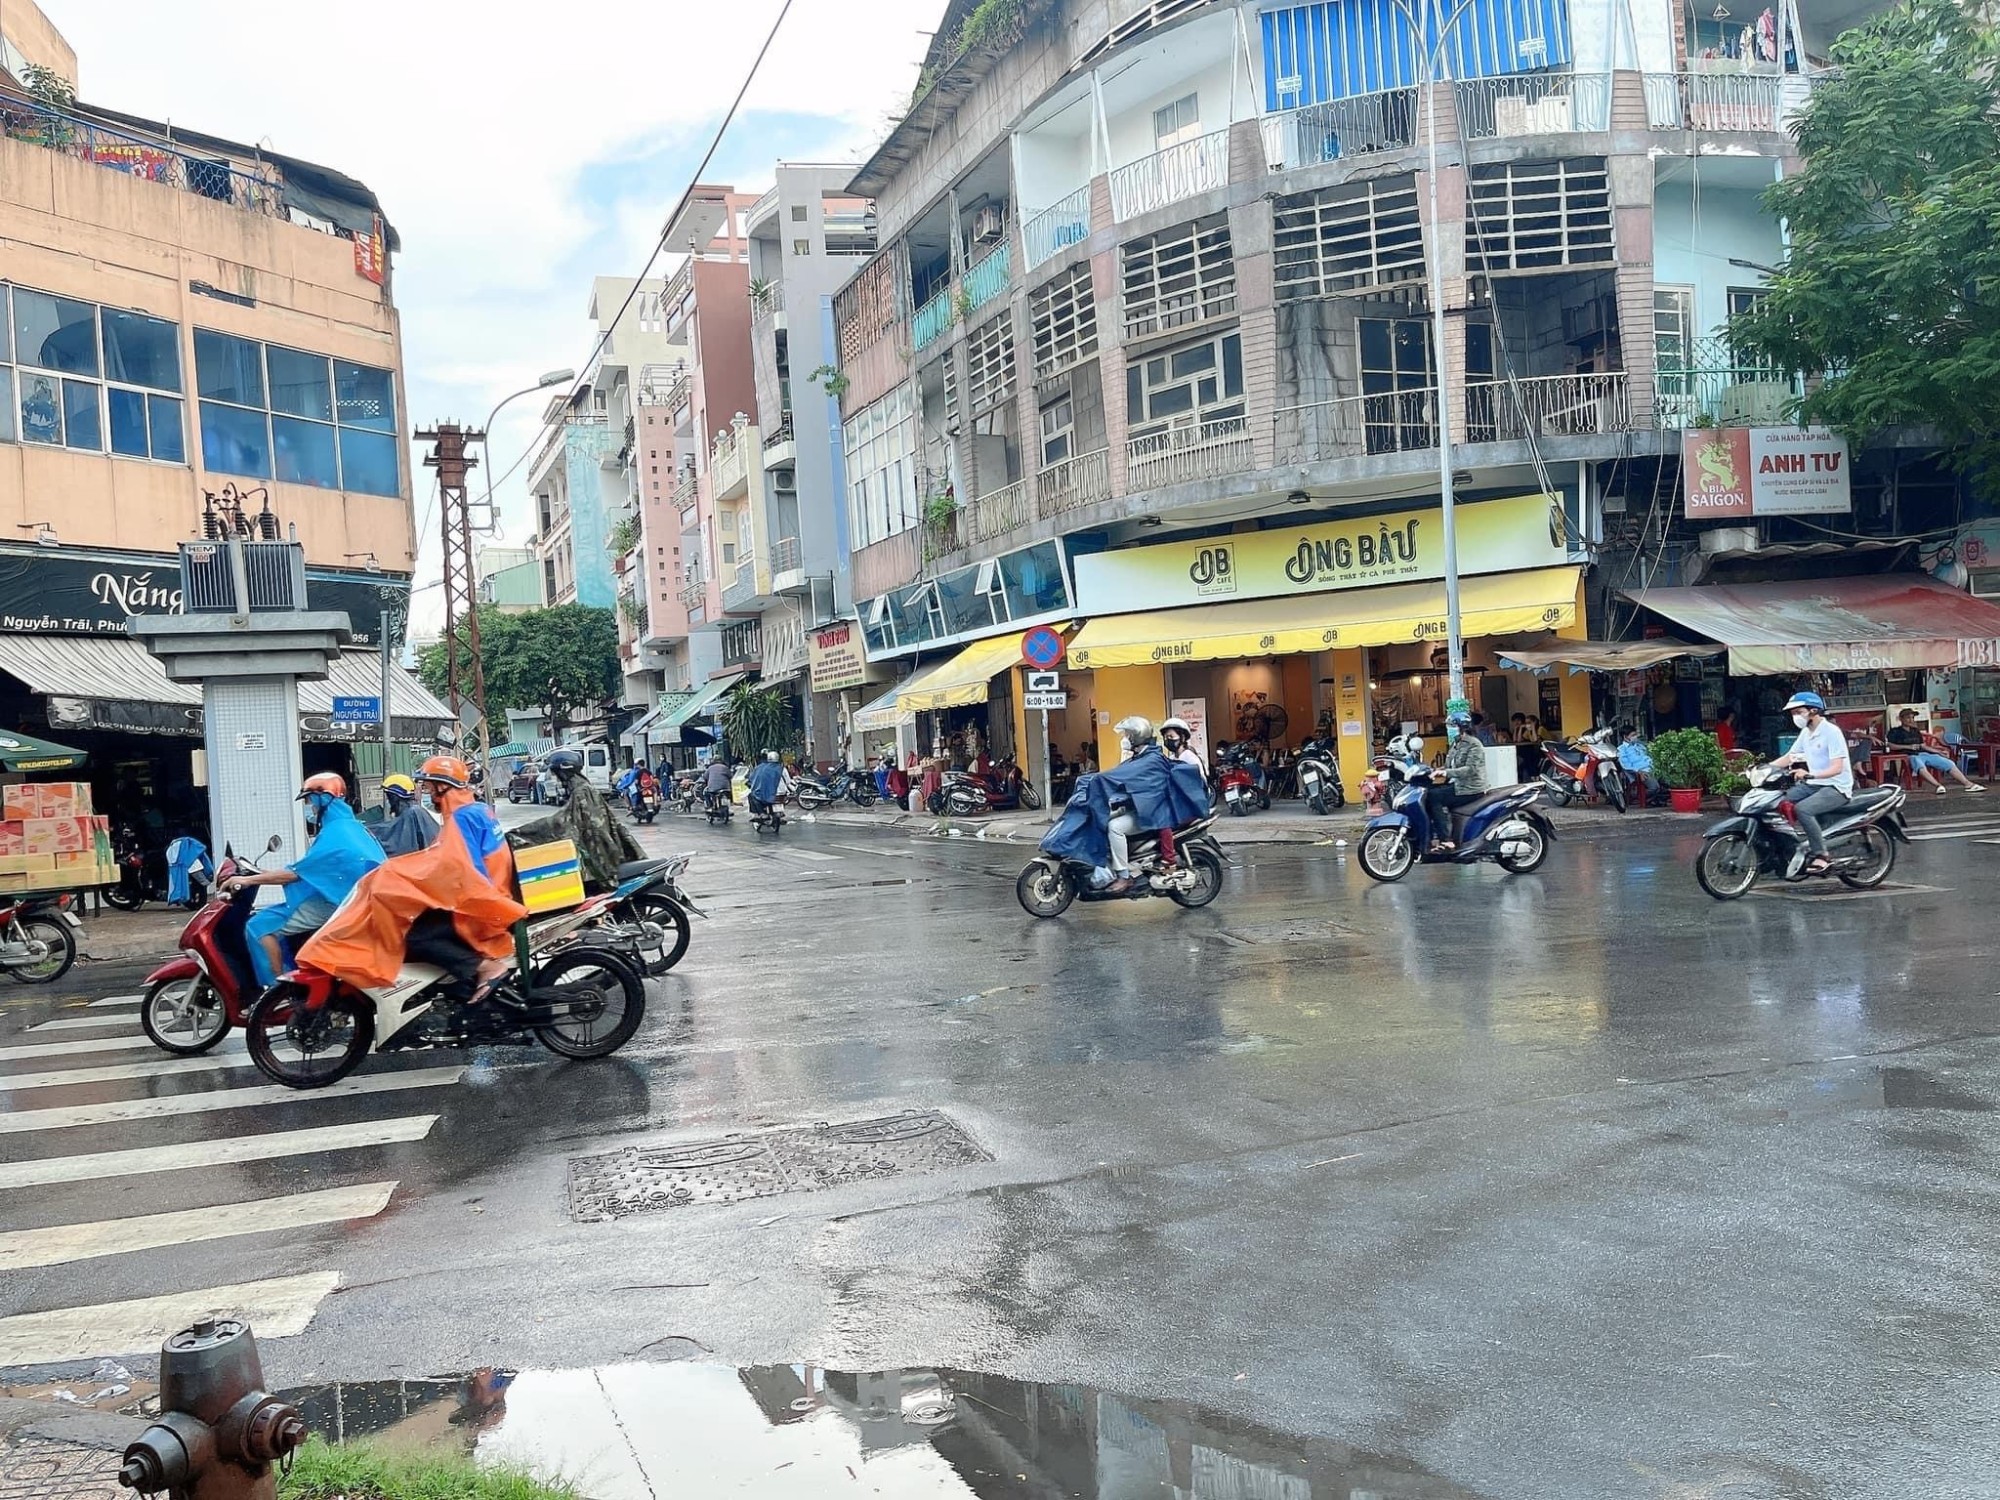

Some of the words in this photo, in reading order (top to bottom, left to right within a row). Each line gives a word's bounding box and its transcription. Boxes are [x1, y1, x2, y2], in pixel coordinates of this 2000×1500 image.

[1759, 454, 1805, 474] ANH
[1810, 451, 1842, 472] TƯ
[1285, 536, 1354, 585] ÔNG
[1358, 519, 1420, 567] BẦU
[3, 615, 59, 631] Nguyễn
[63, 618, 93, 632] Trãi,
